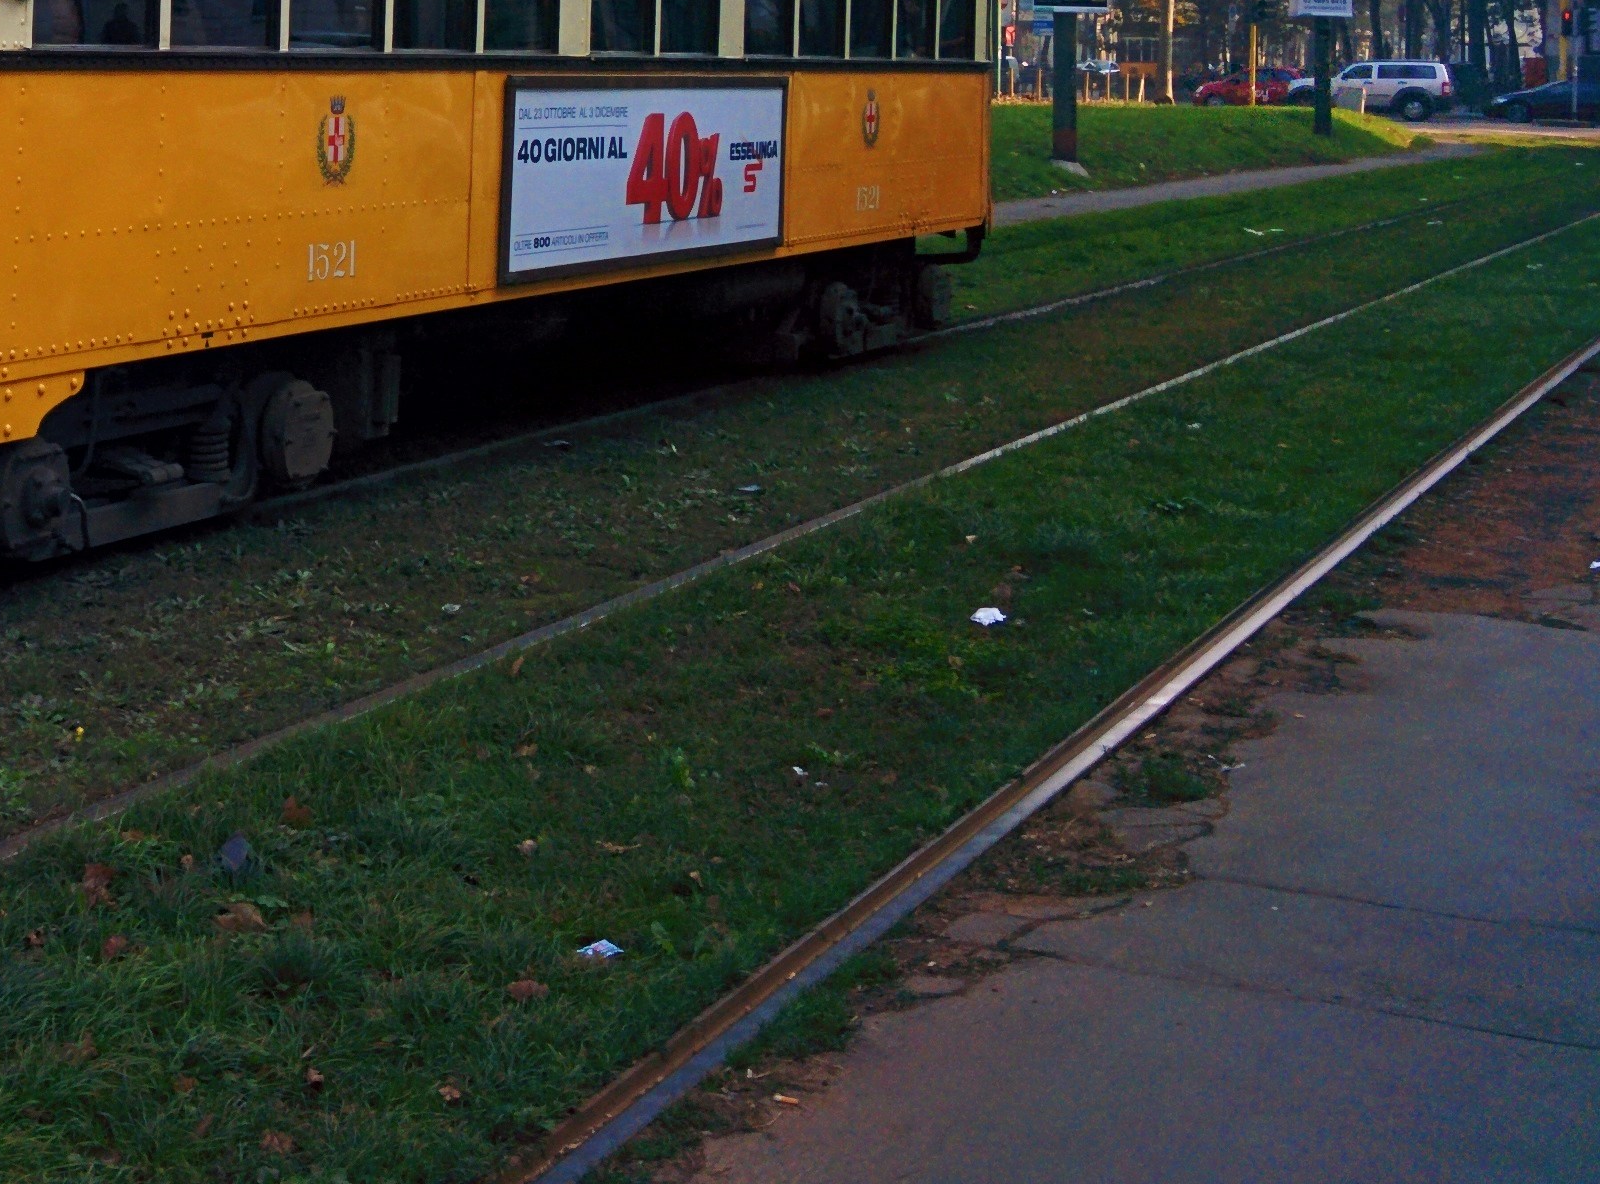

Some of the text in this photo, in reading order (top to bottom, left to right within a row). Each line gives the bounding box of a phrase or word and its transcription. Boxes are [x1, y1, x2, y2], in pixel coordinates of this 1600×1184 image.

[518, 108, 532, 120] DAL
[544, 107, 577, 119] OTTOBRE
[579, 106, 588, 118] AL
[588, 107, 594, 118] 3
[595, 106, 628, 118] DICEMBRE
[517, 136, 628, 163] 40 GIORNI AL
[729, 140, 778, 161] ESSELUNGA
[626, 111, 723, 224] 40%
[513, 240, 532, 251] OLTRE
[533, 237, 551, 248] 800
[551, 235, 576, 247] ARTICOLI
[585, 231, 609, 243] OFFERTA
[308, 240, 356, 282] 1521
